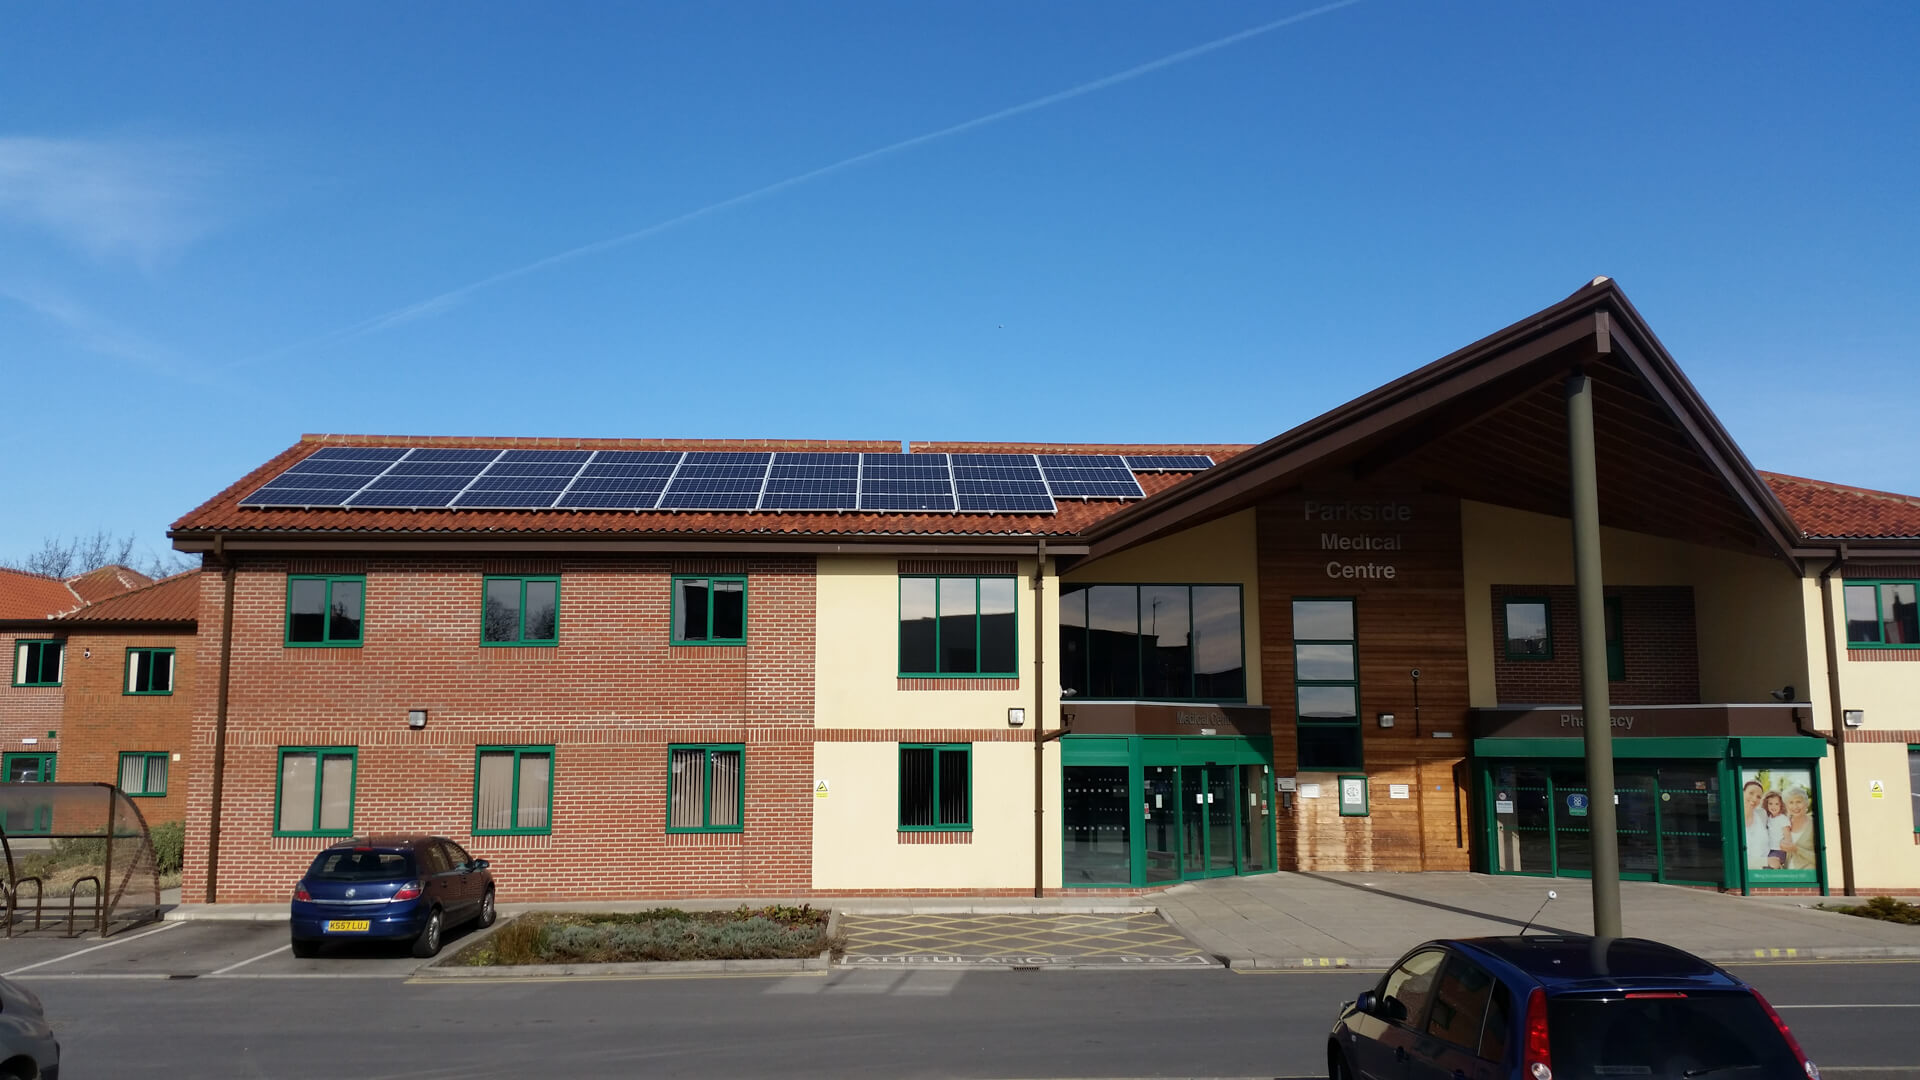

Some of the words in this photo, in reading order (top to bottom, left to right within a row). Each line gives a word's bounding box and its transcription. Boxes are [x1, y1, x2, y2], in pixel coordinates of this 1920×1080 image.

[1304, 500, 1412, 521] Parkside
[1321, 532, 1401, 550] Medical
[1326, 561, 1396, 579] Centre
[1176, 712, 1208, 725] Medical
[1560, 714, 1634, 730] Phacy
[857, 956, 1073, 964] AMBULANCE
